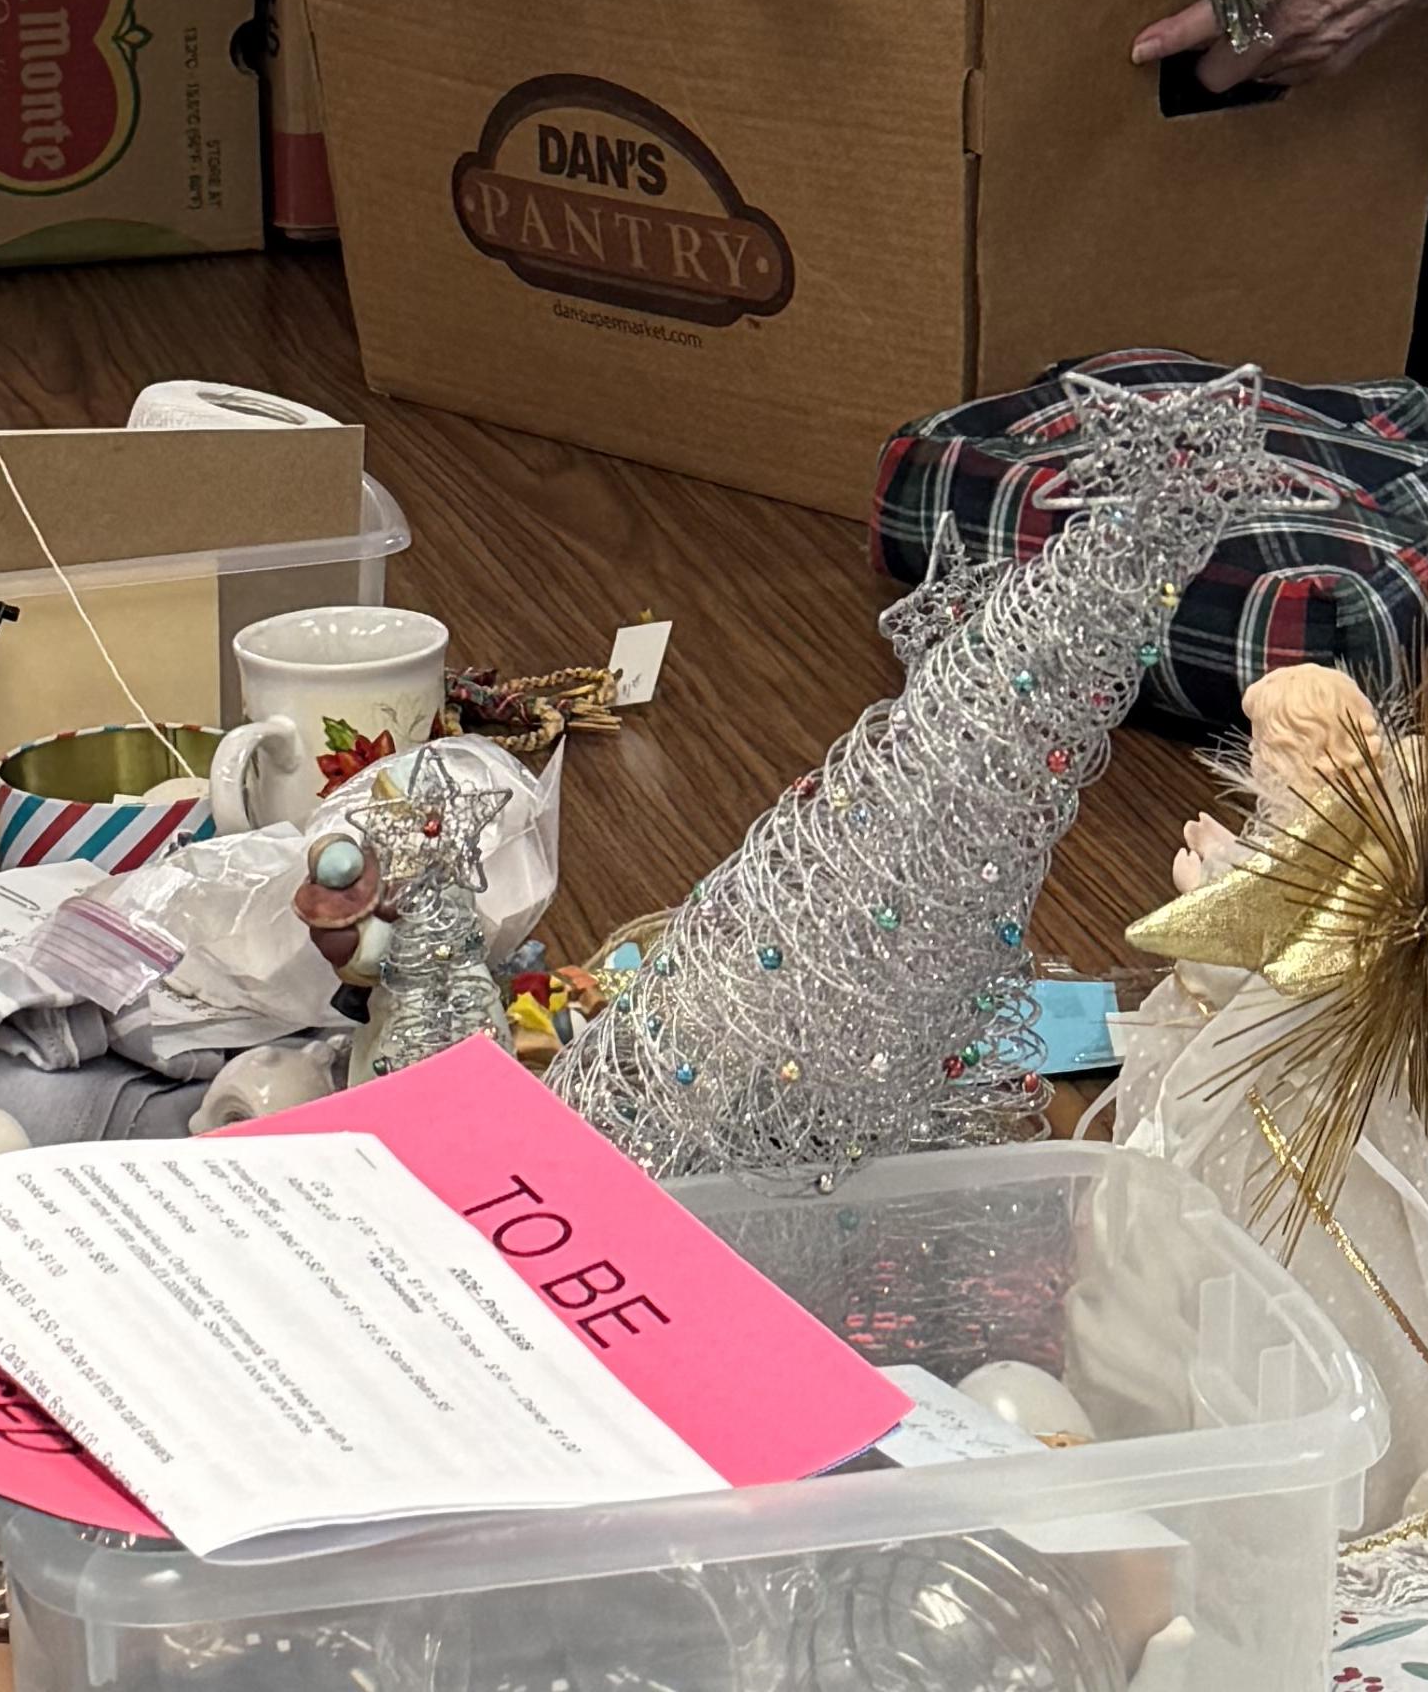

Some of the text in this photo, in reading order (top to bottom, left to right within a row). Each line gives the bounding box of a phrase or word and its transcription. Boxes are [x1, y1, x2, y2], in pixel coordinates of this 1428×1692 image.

[206, 138, 222, 187] STORE
[537, 122, 668, 197] DAN'S
[476, 179, 754, 291] PANTRY
[463, 1173, 671, 1348] TO BE
[475, 1299, 509, 1326] Price
